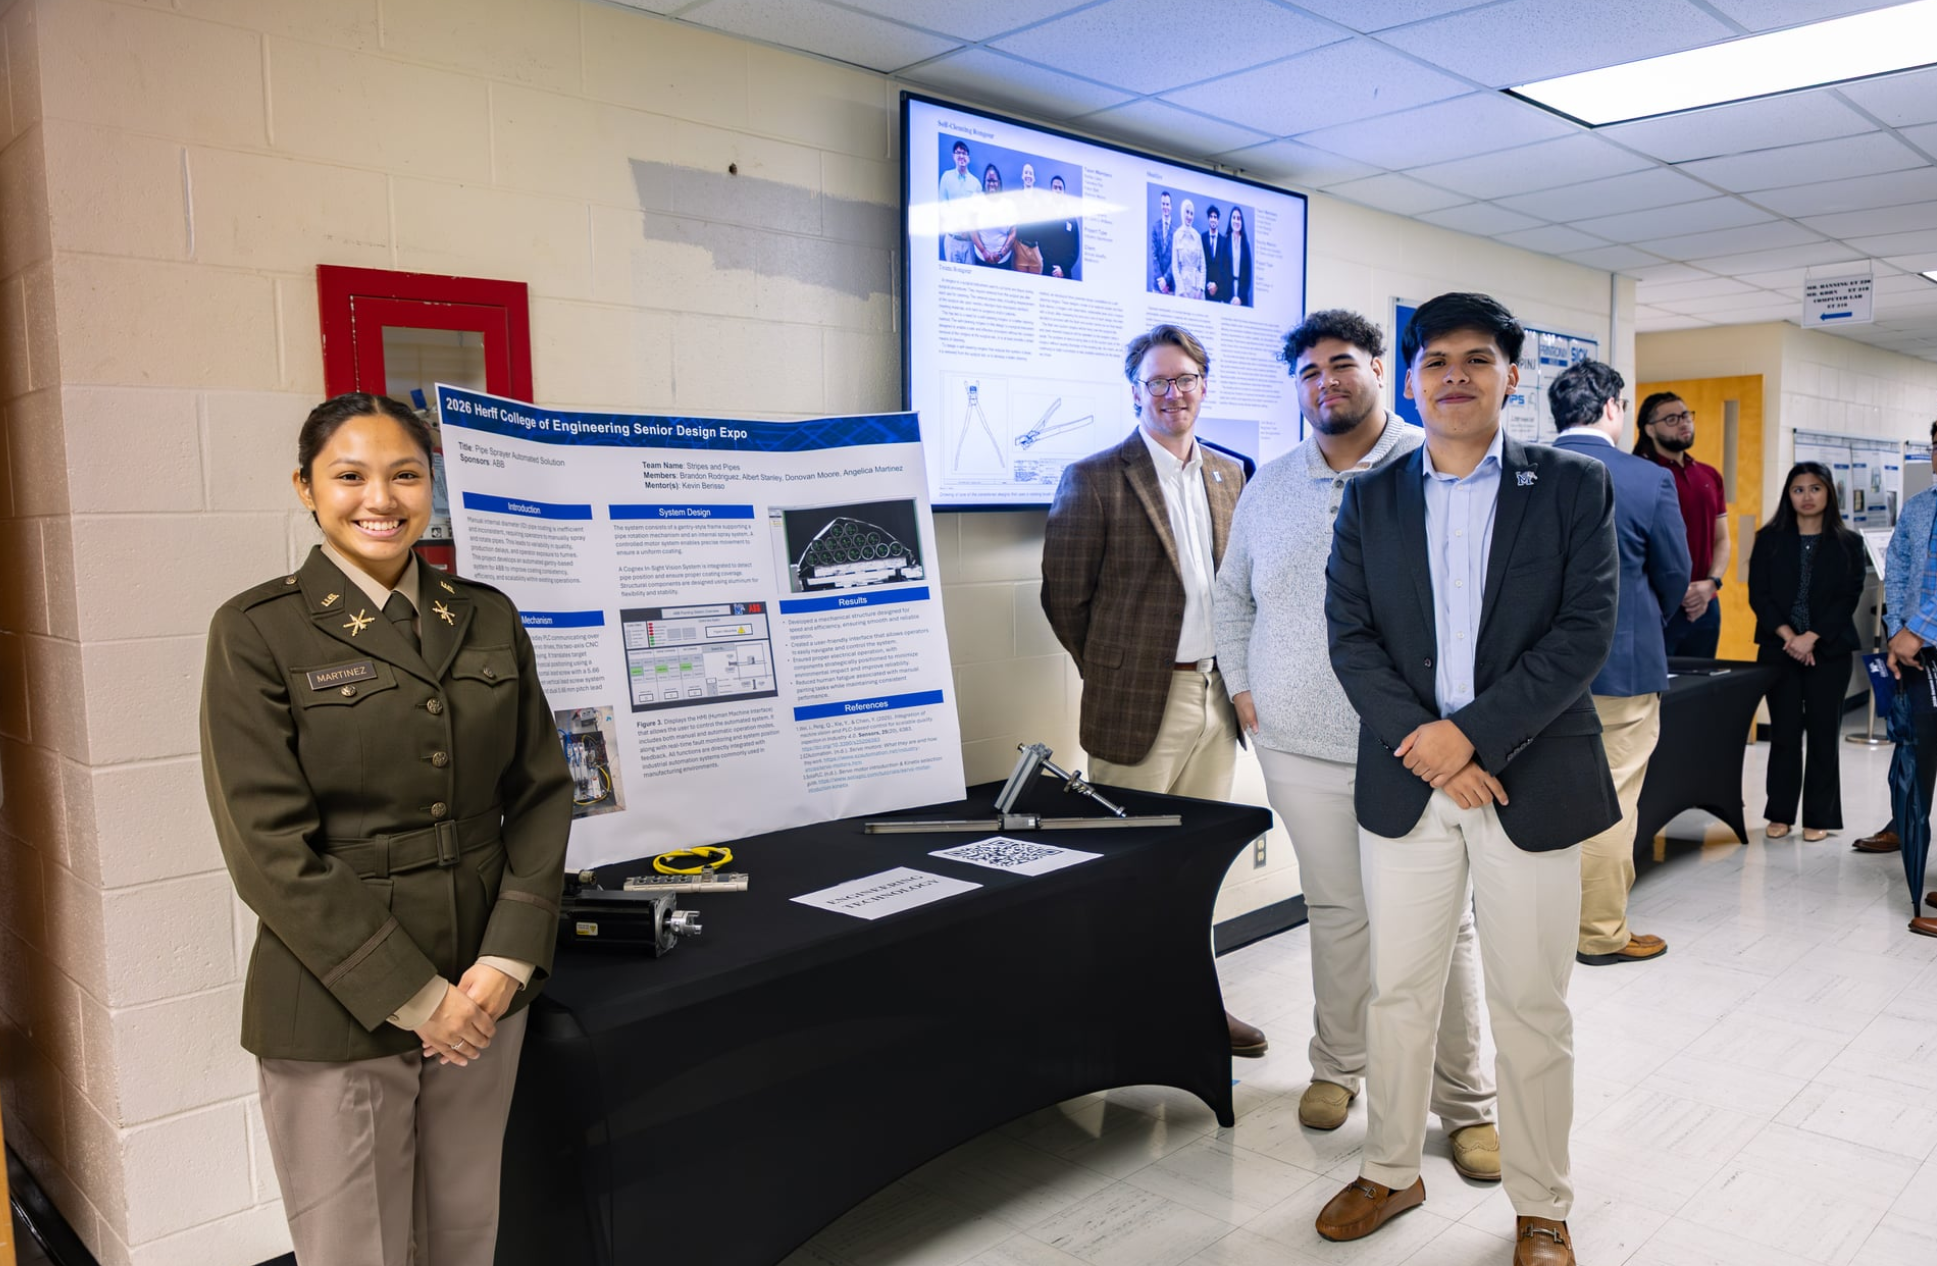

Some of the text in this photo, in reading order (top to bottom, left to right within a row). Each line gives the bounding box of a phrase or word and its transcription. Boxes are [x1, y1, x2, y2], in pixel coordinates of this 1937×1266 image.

[446, 397, 747, 440] 2026 Herff College of Engineering Senior Design Expo
[475, 444, 488, 455] Pipe
[489, 446, 511, 460] Sprayer
[512, 451, 539, 464] Automated
[540, 454, 565, 466] Solution
[492, 459, 505, 468] ABB
[686, 462, 708, 472] Stripes
[723, 463, 740, 472] Pipes
[680, 472, 706, 480] Brandon
[817, 470, 841, 480] Moore,
[843, 466, 873, 477] Angelica
[874, 464, 903, 473] Martinez
[645, 482, 680, 490] Mentor(s):
[507, 502, 541, 514] Introduction
[658, 508, 711, 518] System Design
[838, 597, 868, 606] Results
[749, 604, 761, 612] ABB
[521, 616, 553, 625] Mechanism
[819, 614, 850, 622] mechanical
[877, 608, 901, 618] designed
[904, 628, 929, 637] operators
[316, 666, 367, 683] MARTINEZ
[844, 701, 889, 712] References
[637, 721, 656, 729] Figure
[664, 717, 687, 726] Displays
[724, 717, 751, 725] automated
[826, 874, 924, 905] ENGINEERING
[841, 879, 940, 909] TECHNOLOGY
